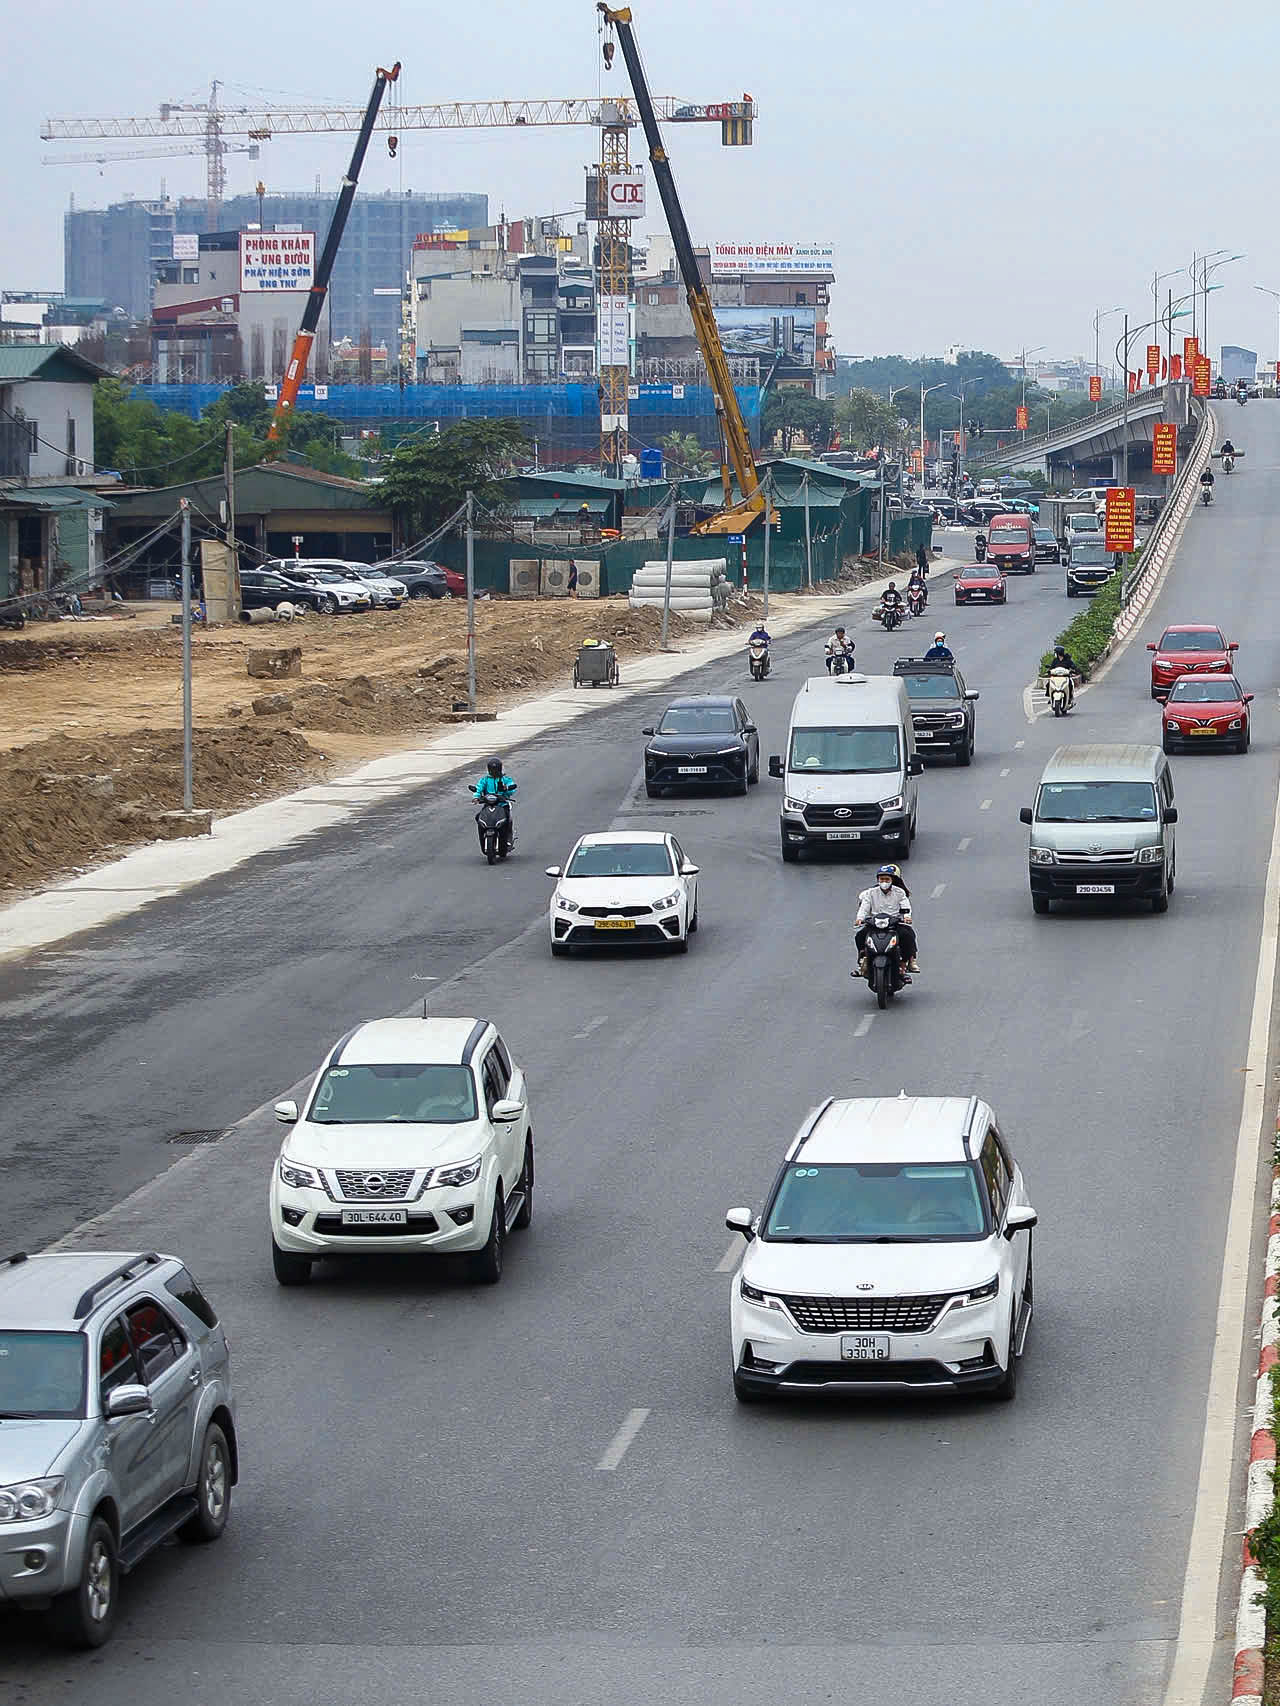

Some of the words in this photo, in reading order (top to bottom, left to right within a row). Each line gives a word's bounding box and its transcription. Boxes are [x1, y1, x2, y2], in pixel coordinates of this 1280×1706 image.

[246, 236, 278, 250] PHÒNG
[281, 236, 310, 250] KHÁM
[738, 246, 754, 255] KHO
[246, 254, 252, 264] K
[348, 1212, 402, 1222] 30L-644.40
[855, 1338, 876, 1348] 30H
[846, 1349, 884, 1359] 330.18
